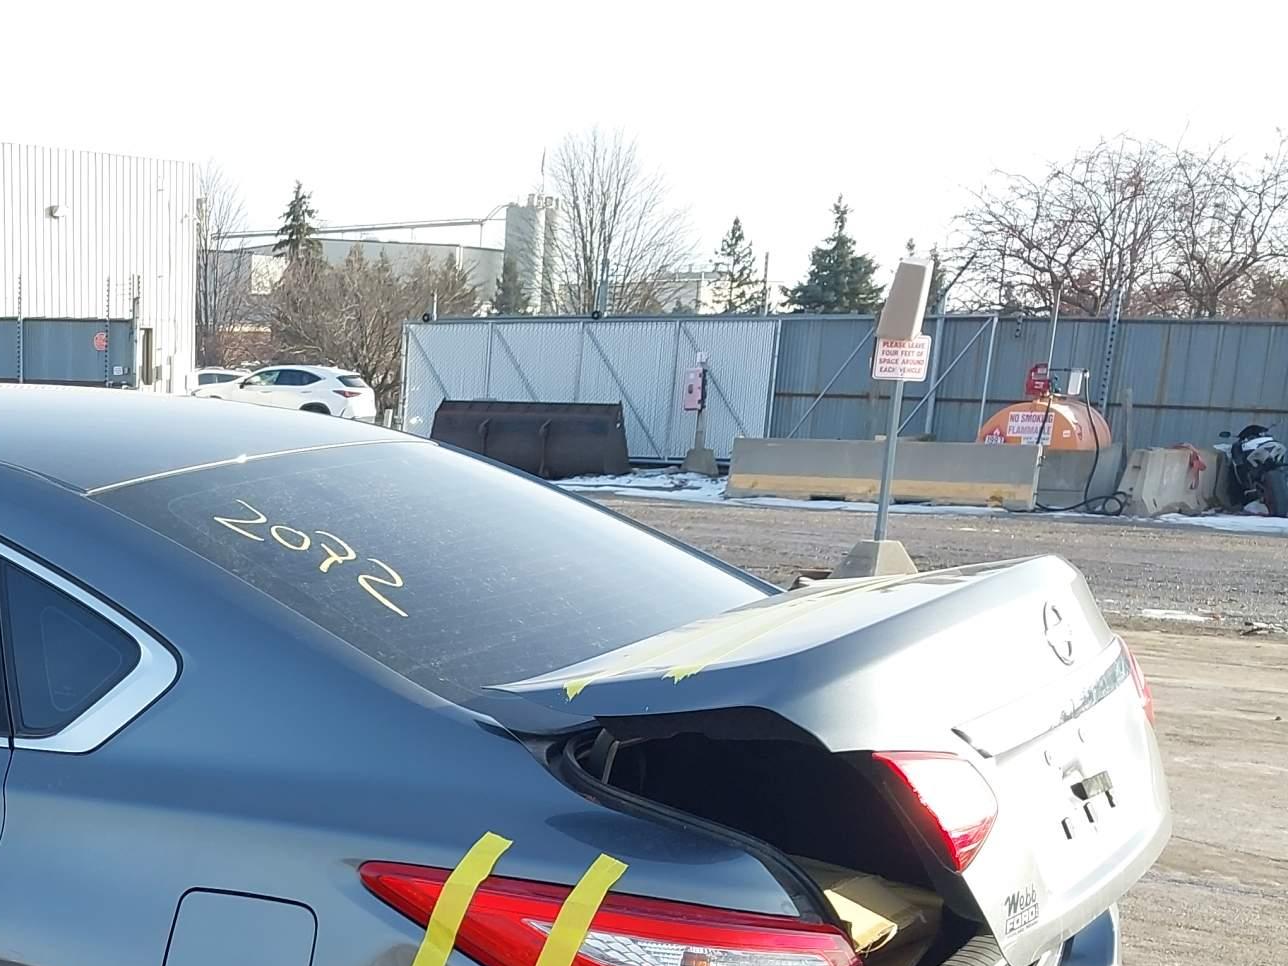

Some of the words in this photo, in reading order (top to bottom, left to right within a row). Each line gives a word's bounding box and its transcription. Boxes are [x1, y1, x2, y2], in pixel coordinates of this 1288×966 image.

[882, 340, 906, 348] PLEASE
[901, 349, 915, 357] FEET
[1010, 414, 1020, 423] NO
[1008, 426, 1051, 435] FLAMMALE
[213, 499, 409, 618] 2072
[1004, 883, 1036, 917] Webb
[1005, 903, 1039, 935] FORD
